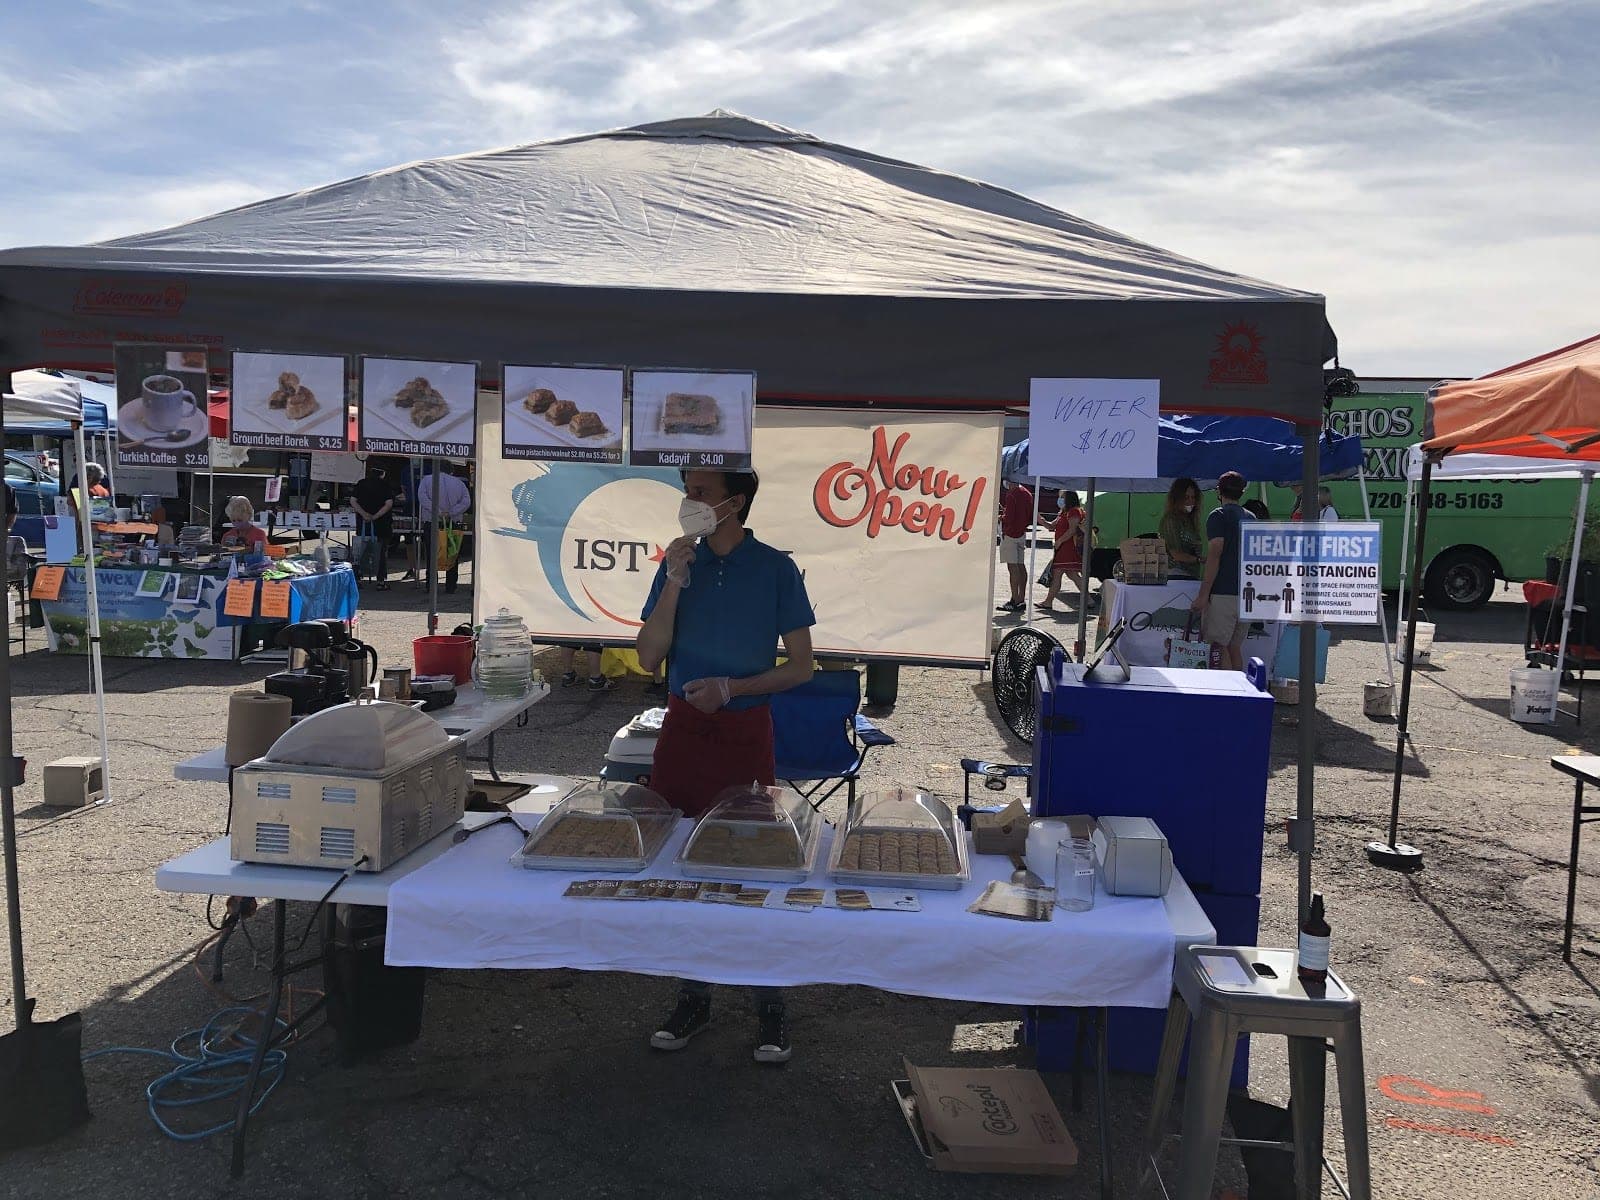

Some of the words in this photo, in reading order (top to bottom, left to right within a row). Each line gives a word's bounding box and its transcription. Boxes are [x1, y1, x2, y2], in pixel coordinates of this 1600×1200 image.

[1054, 396, 1153, 422] WATER
[233, 433, 263, 445] Ground
[264, 434, 281, 446] beef
[281, 435, 309, 447] Borek
[319, 437, 343, 449] $4.25
[365, 439, 399, 453] Spinach
[400, 440, 420, 453] Feta
[420, 441, 446, 455] Borek
[446, 443, 470, 456] $4.00
[1072, 427, 1136, 454] $1.00
[118, 451, 149, 464] Turkish
[150, 452, 177, 464] Coffee
[184, 453, 209, 466] $2.50
[505, 447, 525, 456] Baklava
[593, 450, 607, 459] $5.25
[607, 451, 616, 459] for
[658, 452, 690, 465] Kadayif
[700, 453, 724, 465] $4.00
[866, 425, 967, 498] Now
[812, 461, 987, 547] Open!
[1248, 535, 1316, 557] HEALTH
[1321, 536, 1373, 558] FIRST
[1245, 564, 1293, 577] SOCIAL
[1296, 565, 1377, 578] DISTANCING
